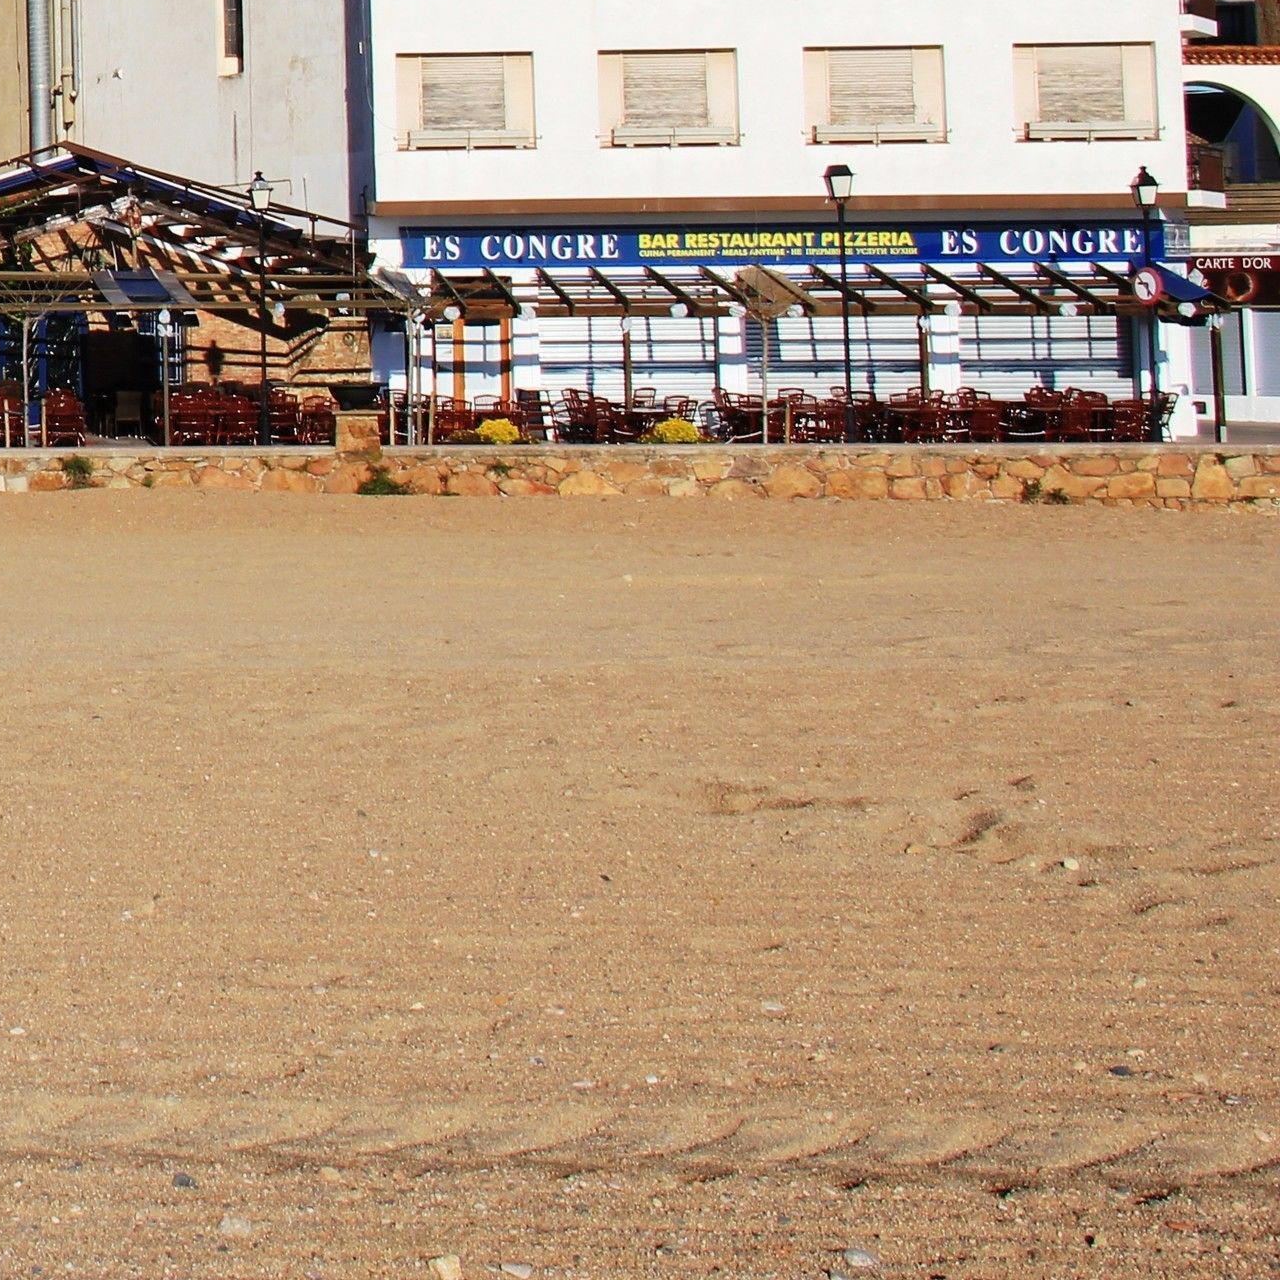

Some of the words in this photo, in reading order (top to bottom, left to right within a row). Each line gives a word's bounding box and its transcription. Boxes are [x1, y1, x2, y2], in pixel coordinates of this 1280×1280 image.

[423, 235, 461, 260] ES
[480, 234, 619, 260] CONGRE
[639, 234, 679, 248] BAR
[685, 232, 815, 248] RESTAURANT
[821, 231, 914, 247] PIZZERIA
[941, 230, 979, 254] ES
[1000, 229, 1141, 254] CONGRE
[639, 249, 664, 258] CUINA
[667, 249, 715, 257] PERMANENT
[721, 248, 748, 257] MEALS
[750, 248, 785, 257] ANYTIME
[1196, 258, 1235, 269] CARTE
